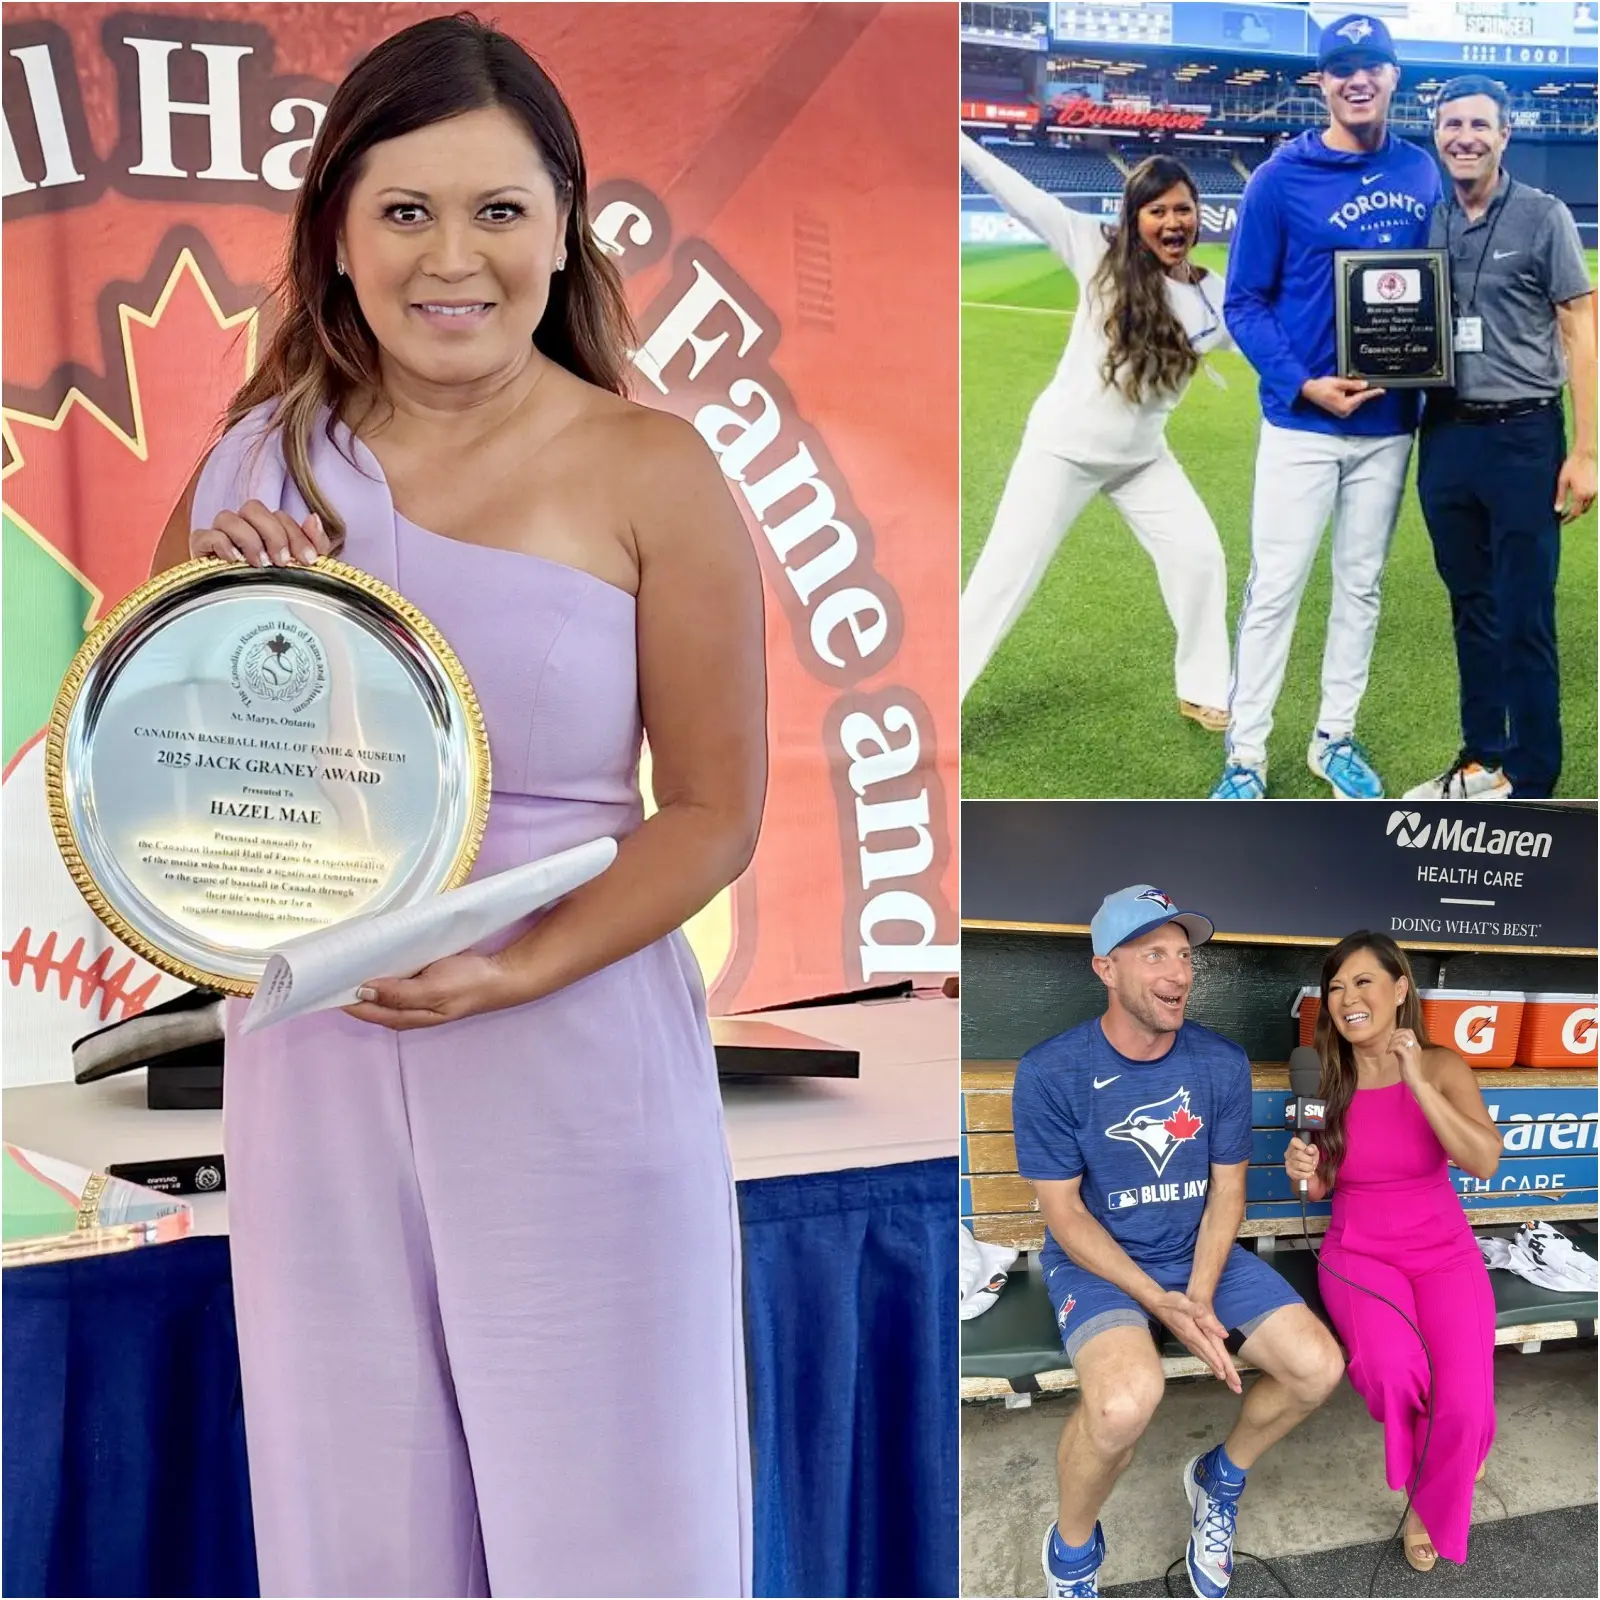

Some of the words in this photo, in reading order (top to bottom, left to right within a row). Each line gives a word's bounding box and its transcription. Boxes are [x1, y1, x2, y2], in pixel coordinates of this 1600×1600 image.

[1055, 100, 1207, 131] Budweiser
[1328, 190, 1426, 231] TORONTO
[122, 36, 330, 192] Ha
[632, 258, 889, 669] Fame
[838, 704, 959, 984] and
[277, 621, 299, 634] Hall
[297, 630, 309, 640] of
[306, 636, 323, 661] Fame
[316, 663, 325, 682] and
[292, 683, 324, 714] Museum
[279, 716, 316, 729] Ontario
[134, 726, 196, 742] CANADIAN
[198, 733, 258, 749] BASEBALL
[259, 739, 292, 752] HALL
[292, 743, 308, 754] OF
[311, 744, 344, 758] FAME
[343, 748, 354, 758] &
[357, 749, 407, 763] MUSEUM
[156, 750, 192, 768] 2025
[194, 754, 242, 772] JACK
[245, 759, 318, 779] GRANEY
[320, 767, 382, 786] AWARD
[241, 785, 279, 798] Presented
[281, 789, 294, 798] To
[210, 800, 275, 821] HAZEL
[279, 806, 322, 825] MAE
[138, 840, 153, 849] the
[1431, 818, 1553, 858] McLaren
[142, 855, 153, 864] of
[153, 856, 169, 865] the
[164, 872, 175, 880] to
[176, 873, 192, 882] the
[218, 877, 230, 886] of
[281, 882, 316, 894] Canada
[1417, 866, 1479, 885] HEALTH
[1483, 870, 1524, 888] CARE
[1390, 917, 1441, 933] DOING
[1445, 920, 1500, 936] WHAT'S
[1453, 1005, 1499, 1055] G
[1304, 1104, 1325, 1118] SN
[1141, 1183, 1181, 1204] BLUE
[1182, 1179, 1209, 1200] JAY
[1501, 1173, 1566, 1197] CARE
